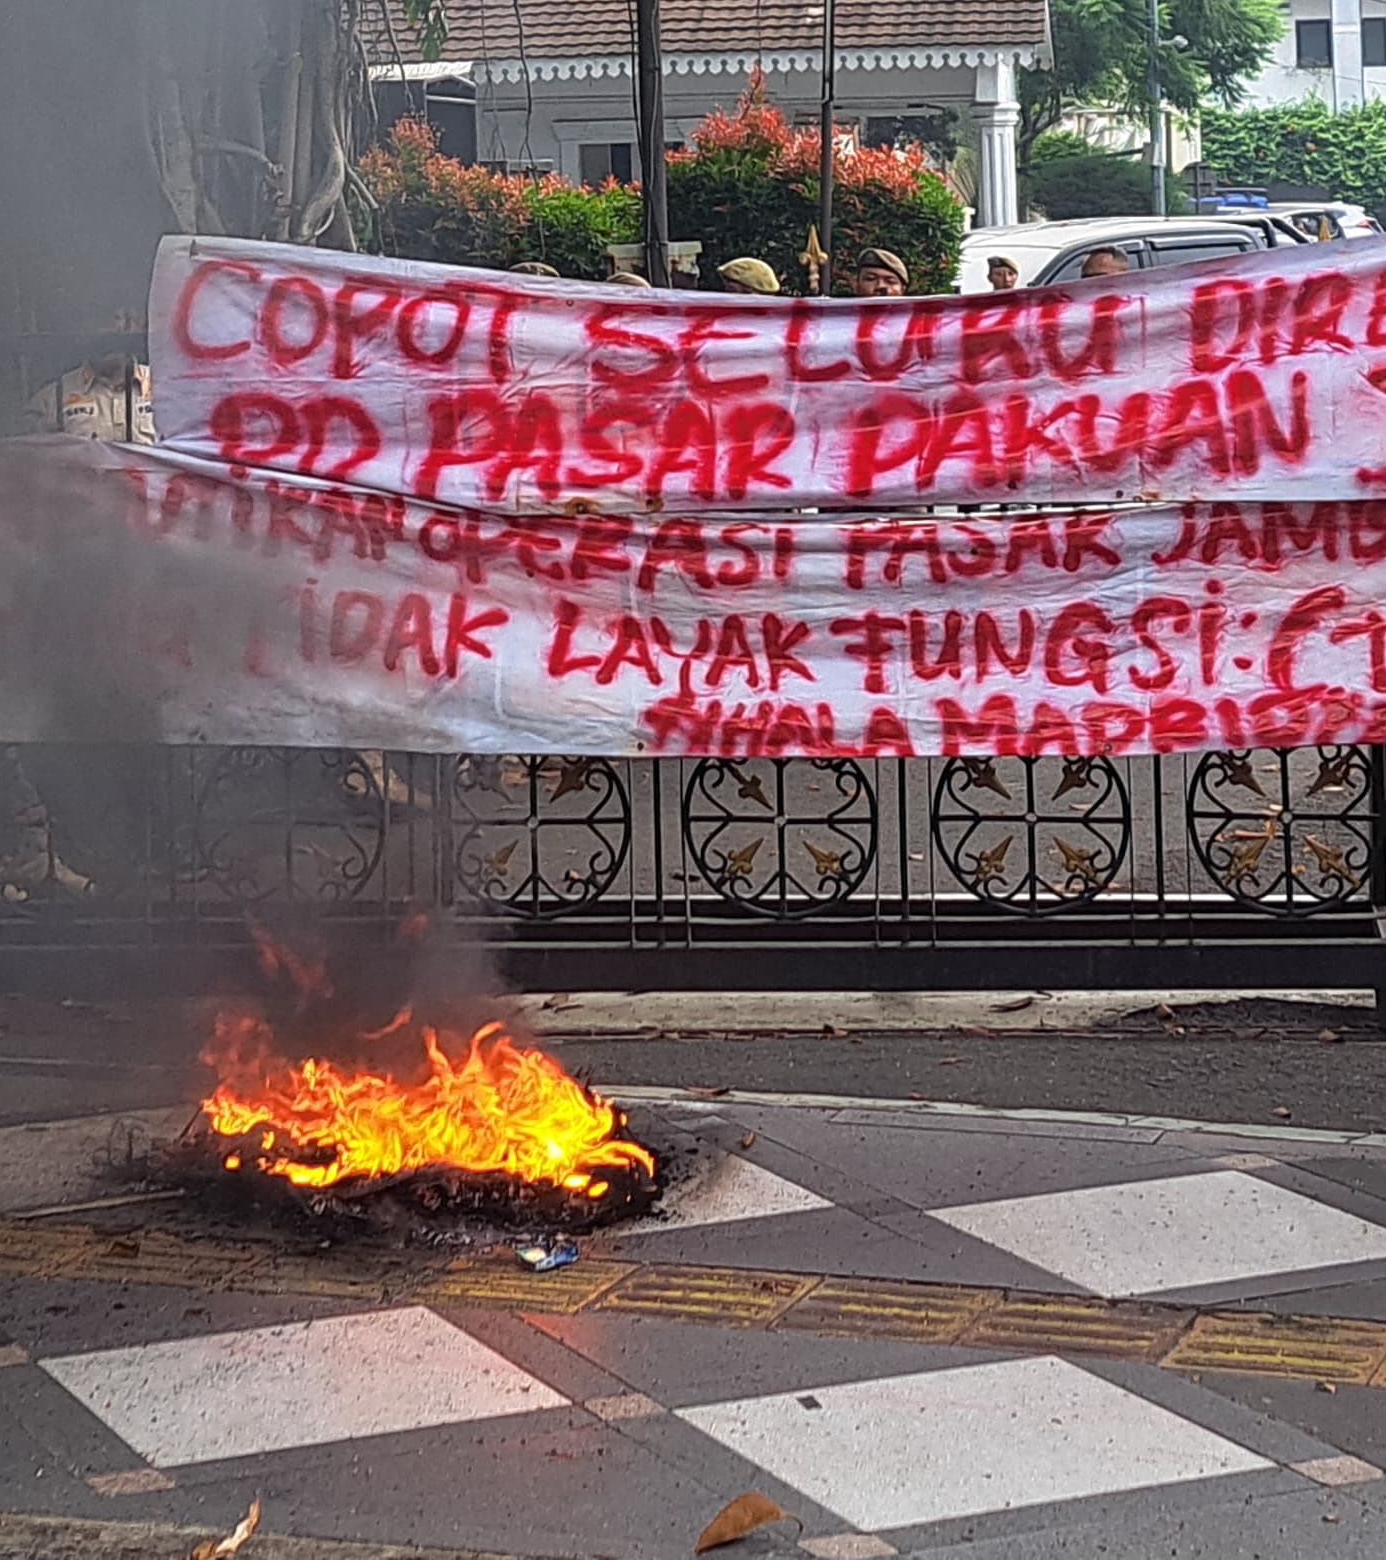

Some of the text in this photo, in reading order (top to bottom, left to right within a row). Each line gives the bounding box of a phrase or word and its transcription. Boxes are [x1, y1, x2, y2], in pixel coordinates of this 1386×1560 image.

[173, 260, 548, 383] COPOT
[211, 392, 381, 480] PD
[415, 388, 795, 501] PASAR
[843, 370, 1311, 497] PAKUAN
[418, 510, 794, 592] OPERASI
[839, 516, 1120, 589] PASAR
[547, 600, 815, 700] LAYAK
